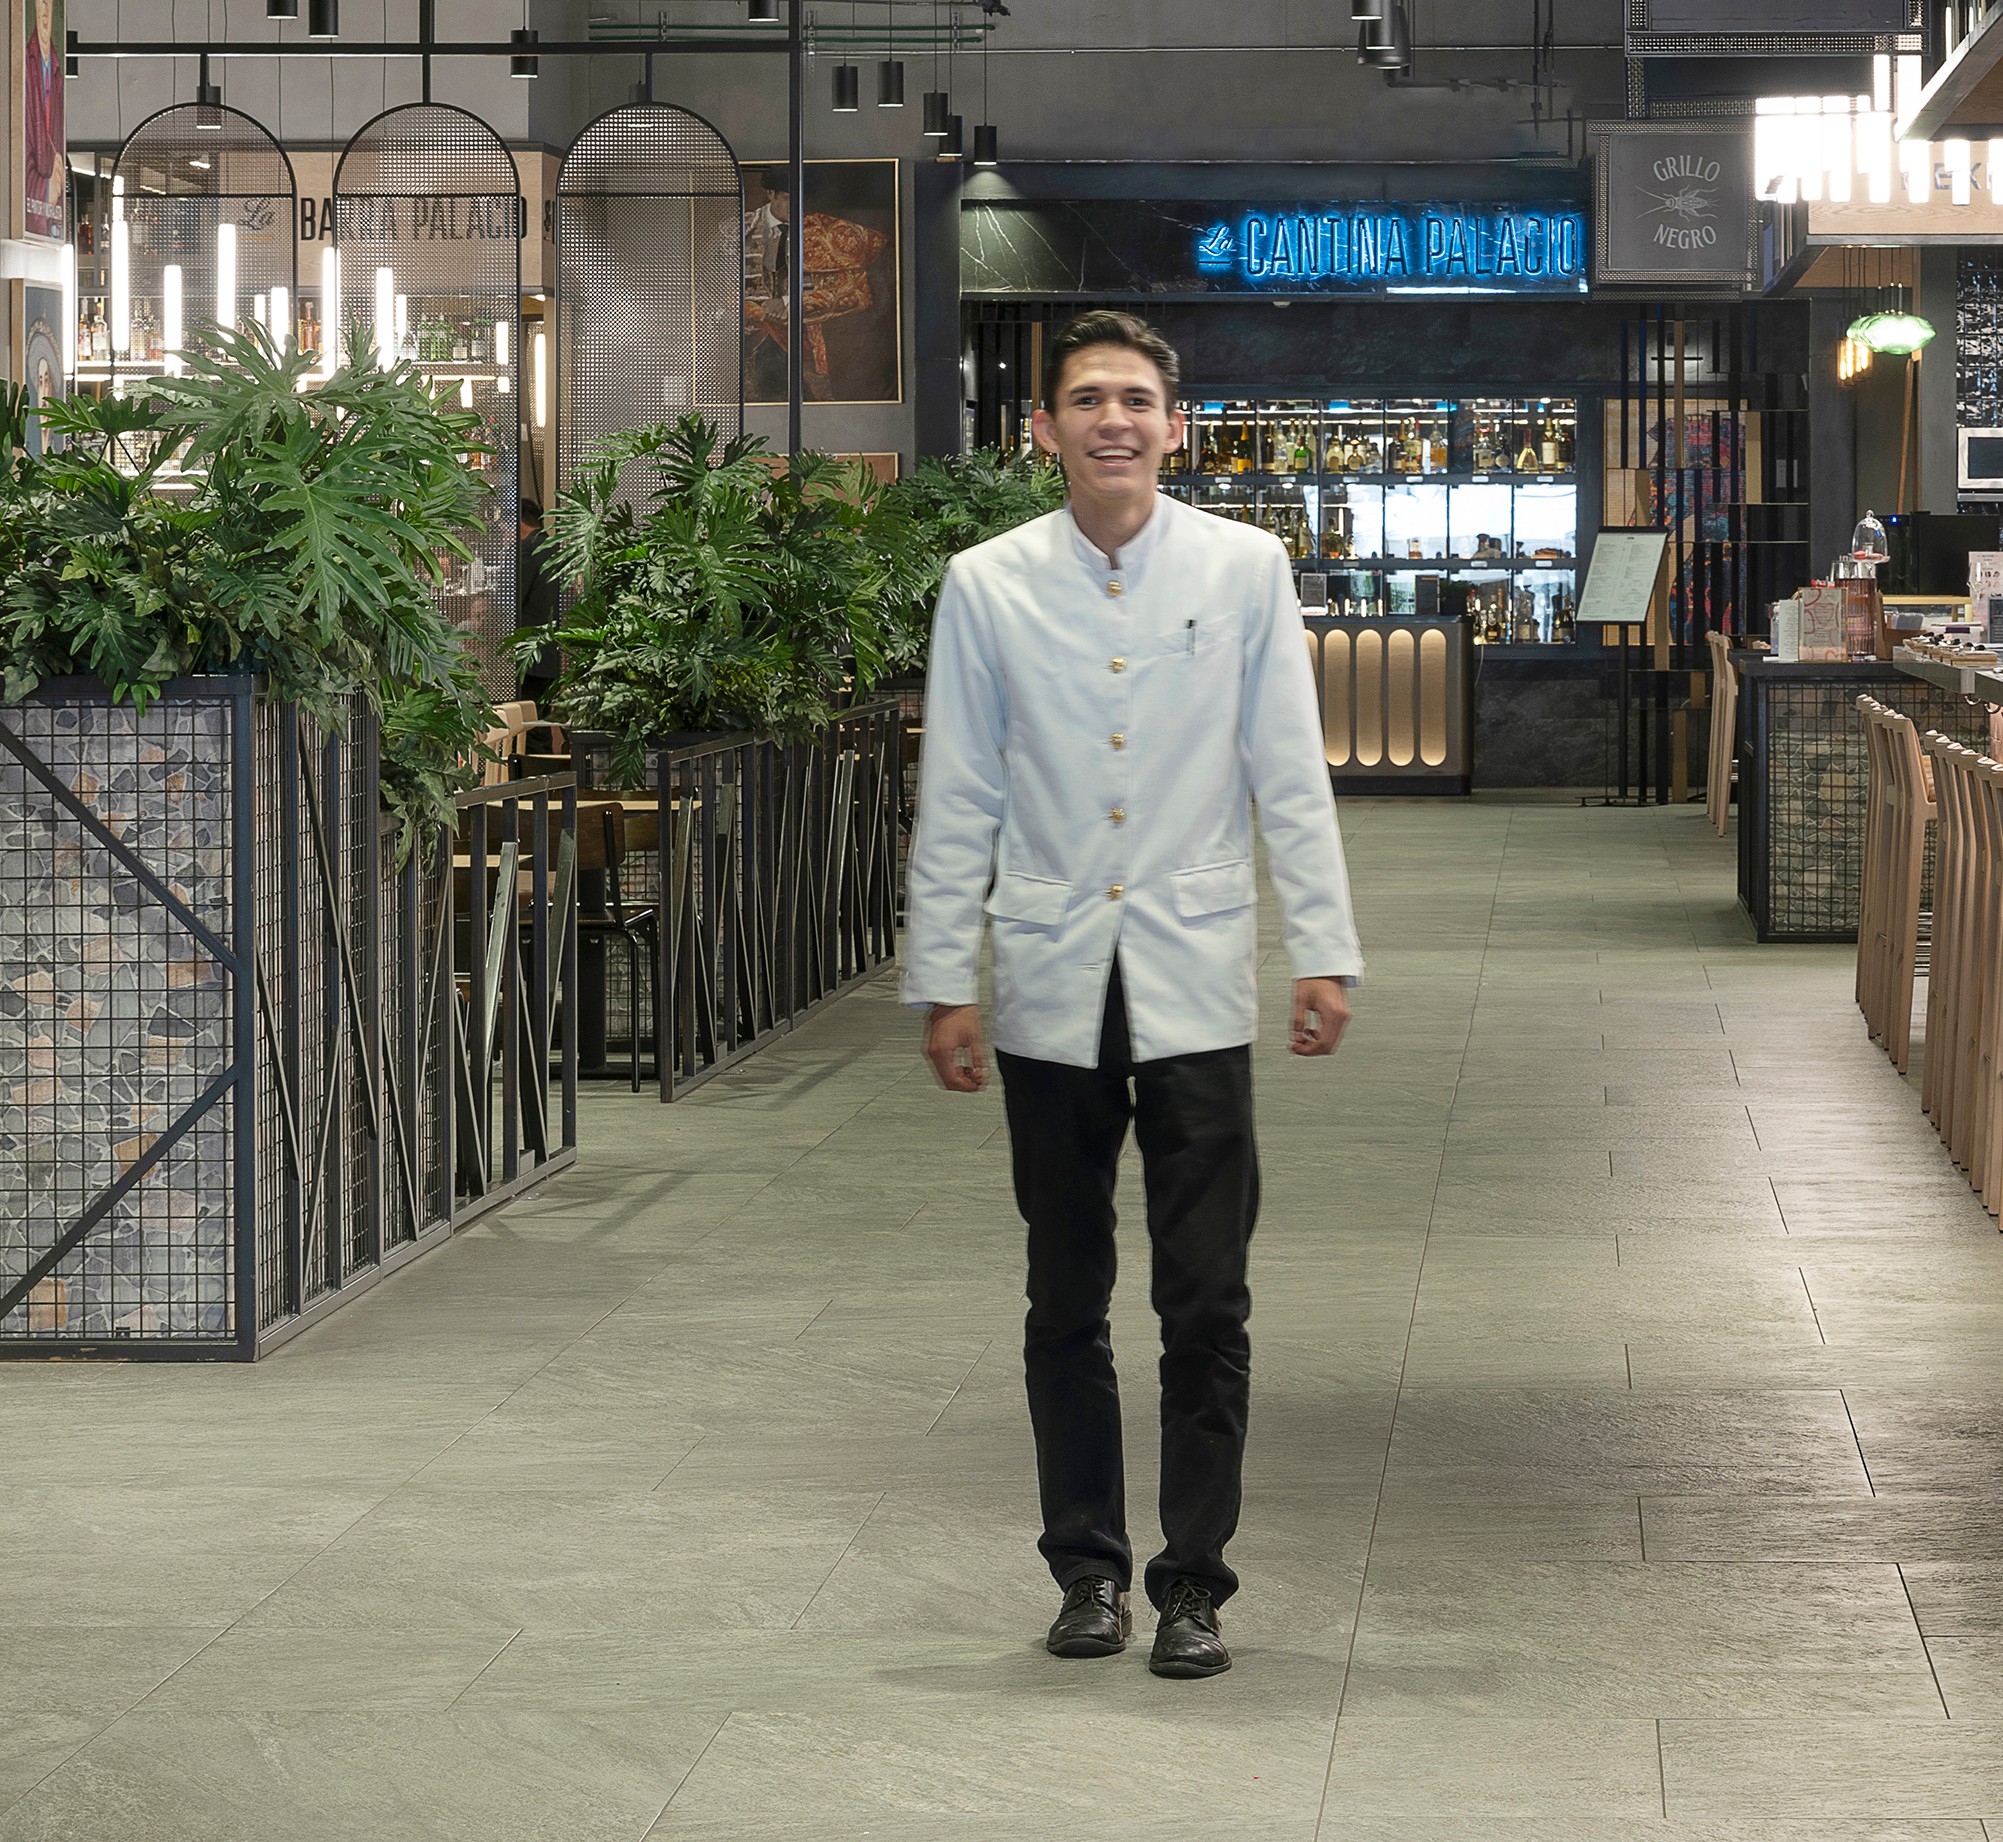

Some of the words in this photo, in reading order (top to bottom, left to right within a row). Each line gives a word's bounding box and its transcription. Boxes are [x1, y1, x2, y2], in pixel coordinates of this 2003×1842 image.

[1653, 154, 1720, 181] GRILLO
[300, 197, 398, 240] BARRA
[411, 197, 527, 240] PALACIO
[1653, 223, 1717, 249] NEGRO
[1198, 226, 1234, 256] La
[1246, 217, 1407, 276] CANTINA
[1426, 217, 1577, 276] PALACIO
